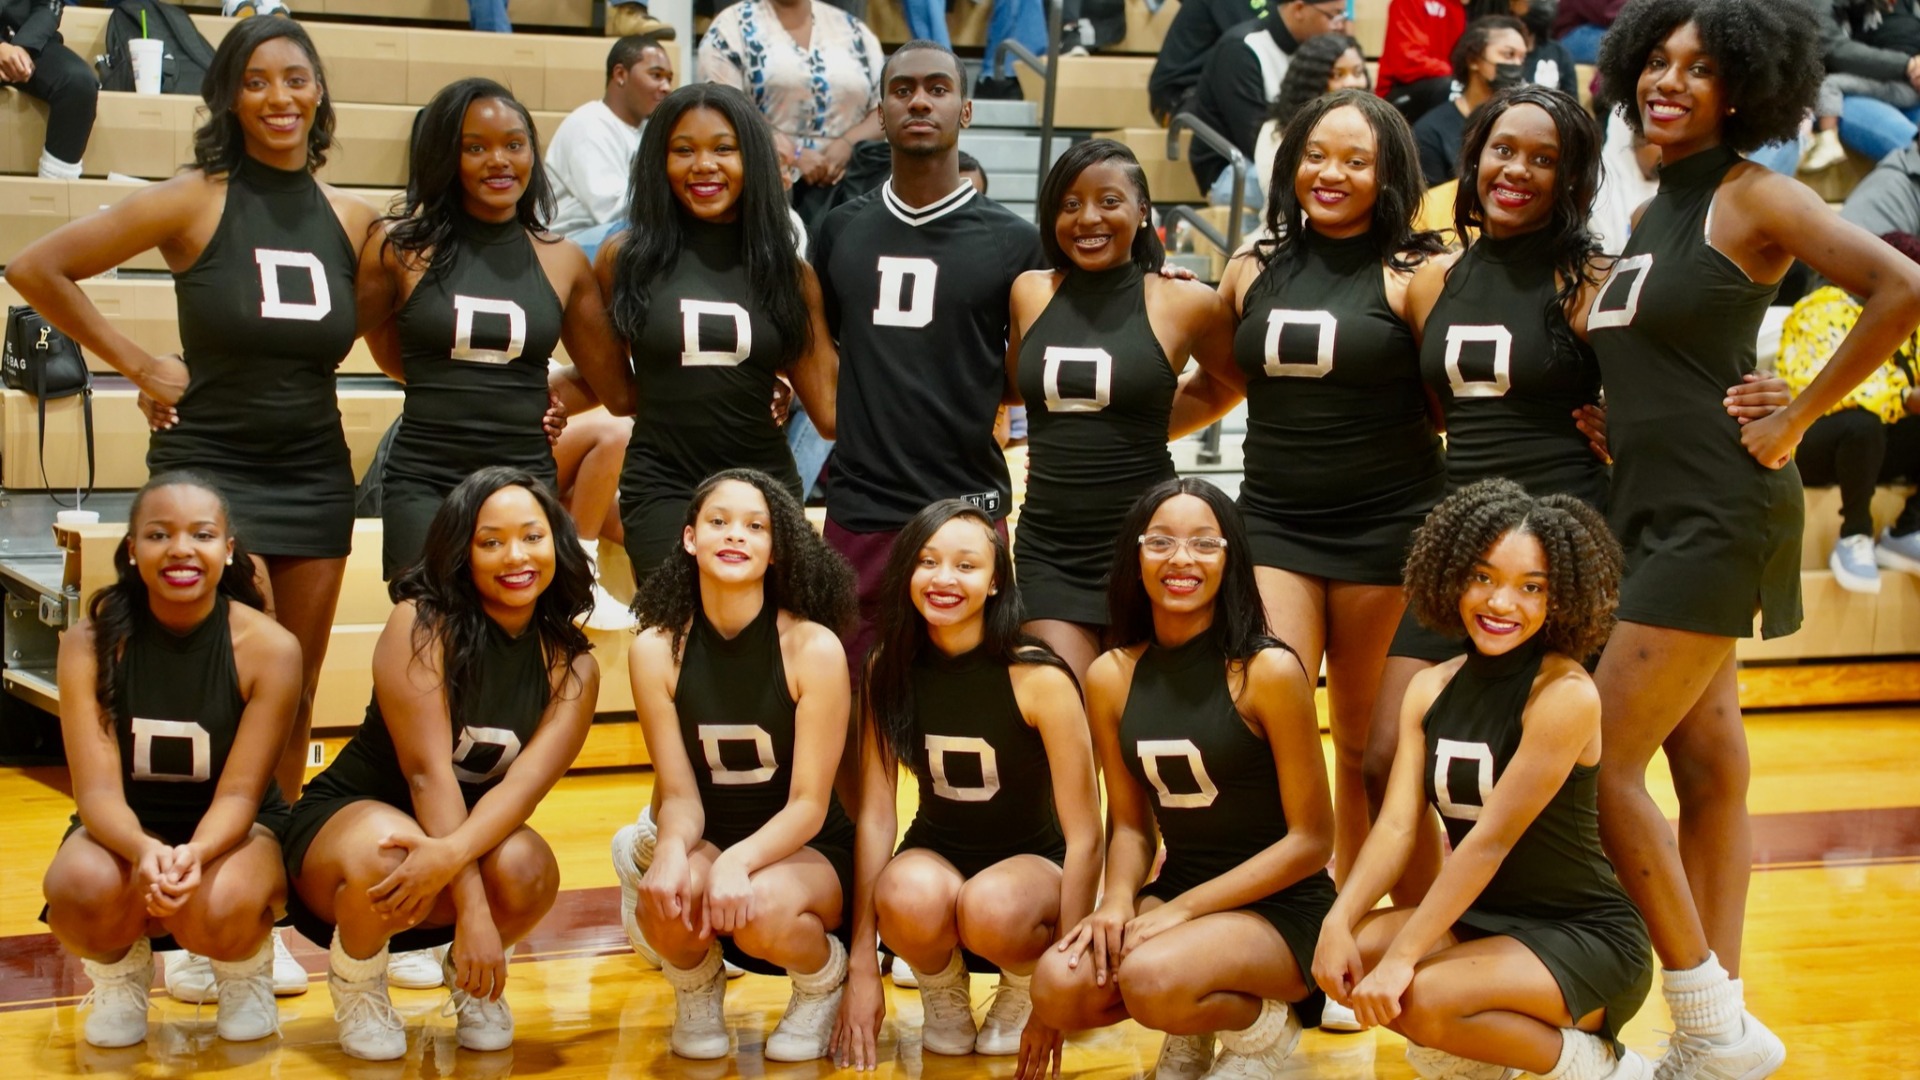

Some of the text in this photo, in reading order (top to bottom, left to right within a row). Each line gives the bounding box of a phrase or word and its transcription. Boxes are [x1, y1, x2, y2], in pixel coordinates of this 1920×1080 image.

[255, 248, 331, 321] D
[873, 256, 938, 328] D
[1587, 253, 1653, 331] D
[451, 295, 526, 364] D
[680, 299, 751, 366] D
[1265, 309, 1337, 378] D
[1445, 325, 1512, 398] D
[1044, 346, 1112, 412] D
[132, 718, 210, 783] D
[453, 726, 521, 784] D
[698, 724, 779, 785] D
[925, 734, 1001, 802] D
[1136, 738, 1218, 808] D
[1434, 738, 1494, 821] D
